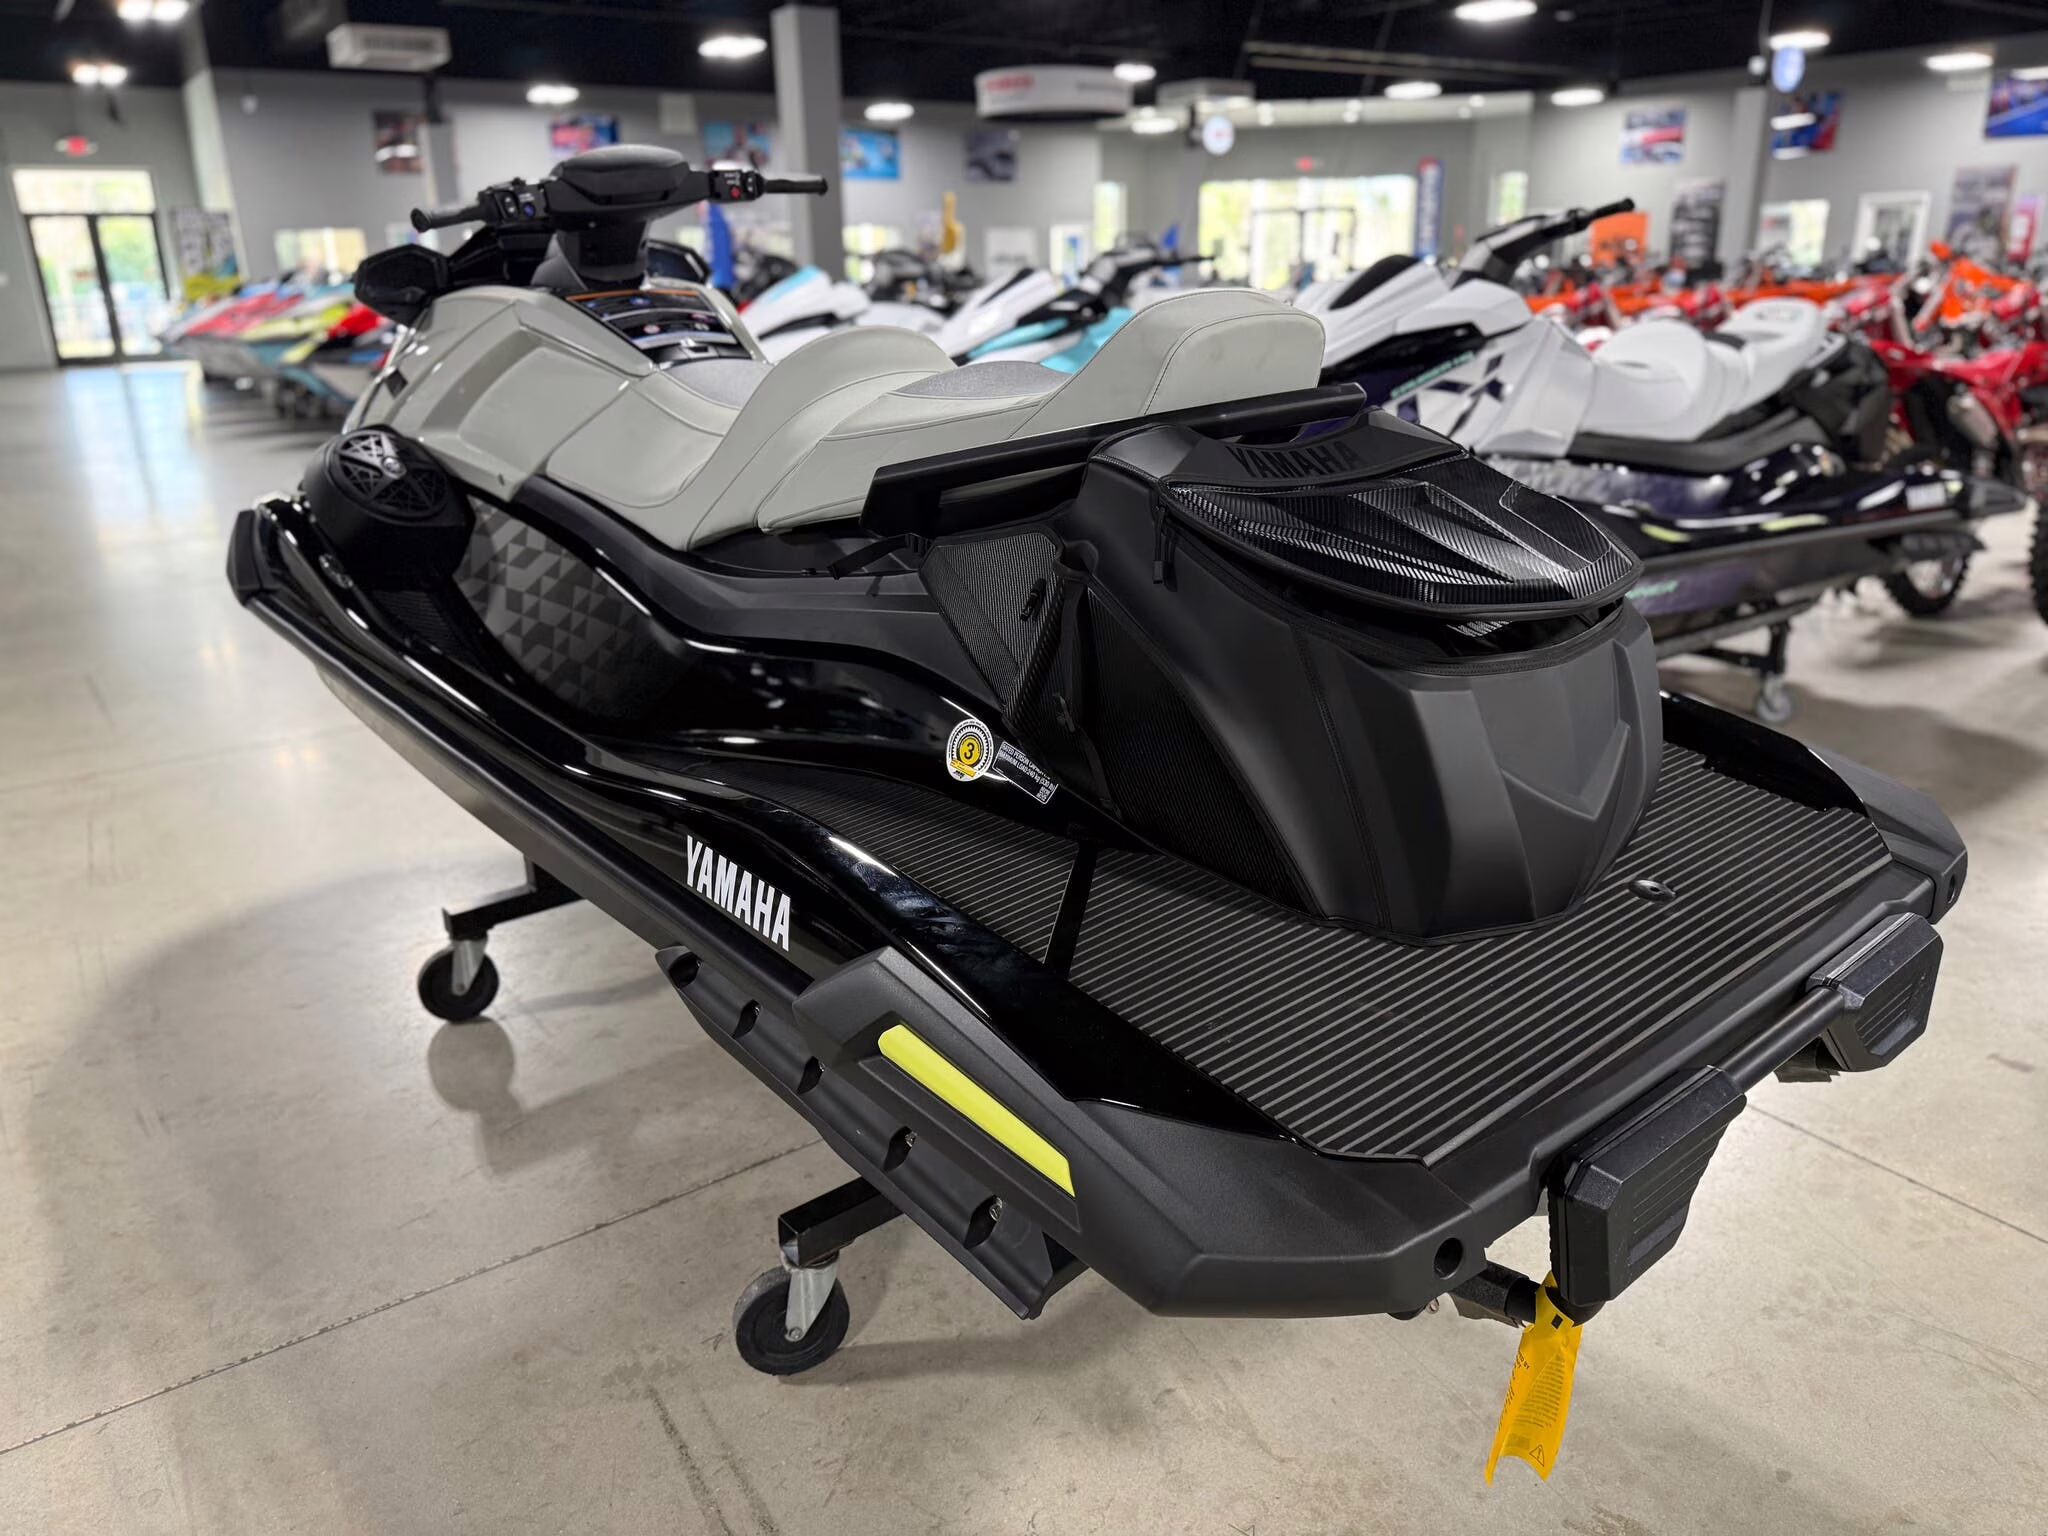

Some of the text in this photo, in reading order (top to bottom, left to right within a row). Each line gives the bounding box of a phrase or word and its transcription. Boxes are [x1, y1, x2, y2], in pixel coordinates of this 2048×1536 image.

[1225, 441, 1367, 478] YAMAHA
[964, 742, 975, 759] 3
[687, 834, 791, 952] YAMAHA
